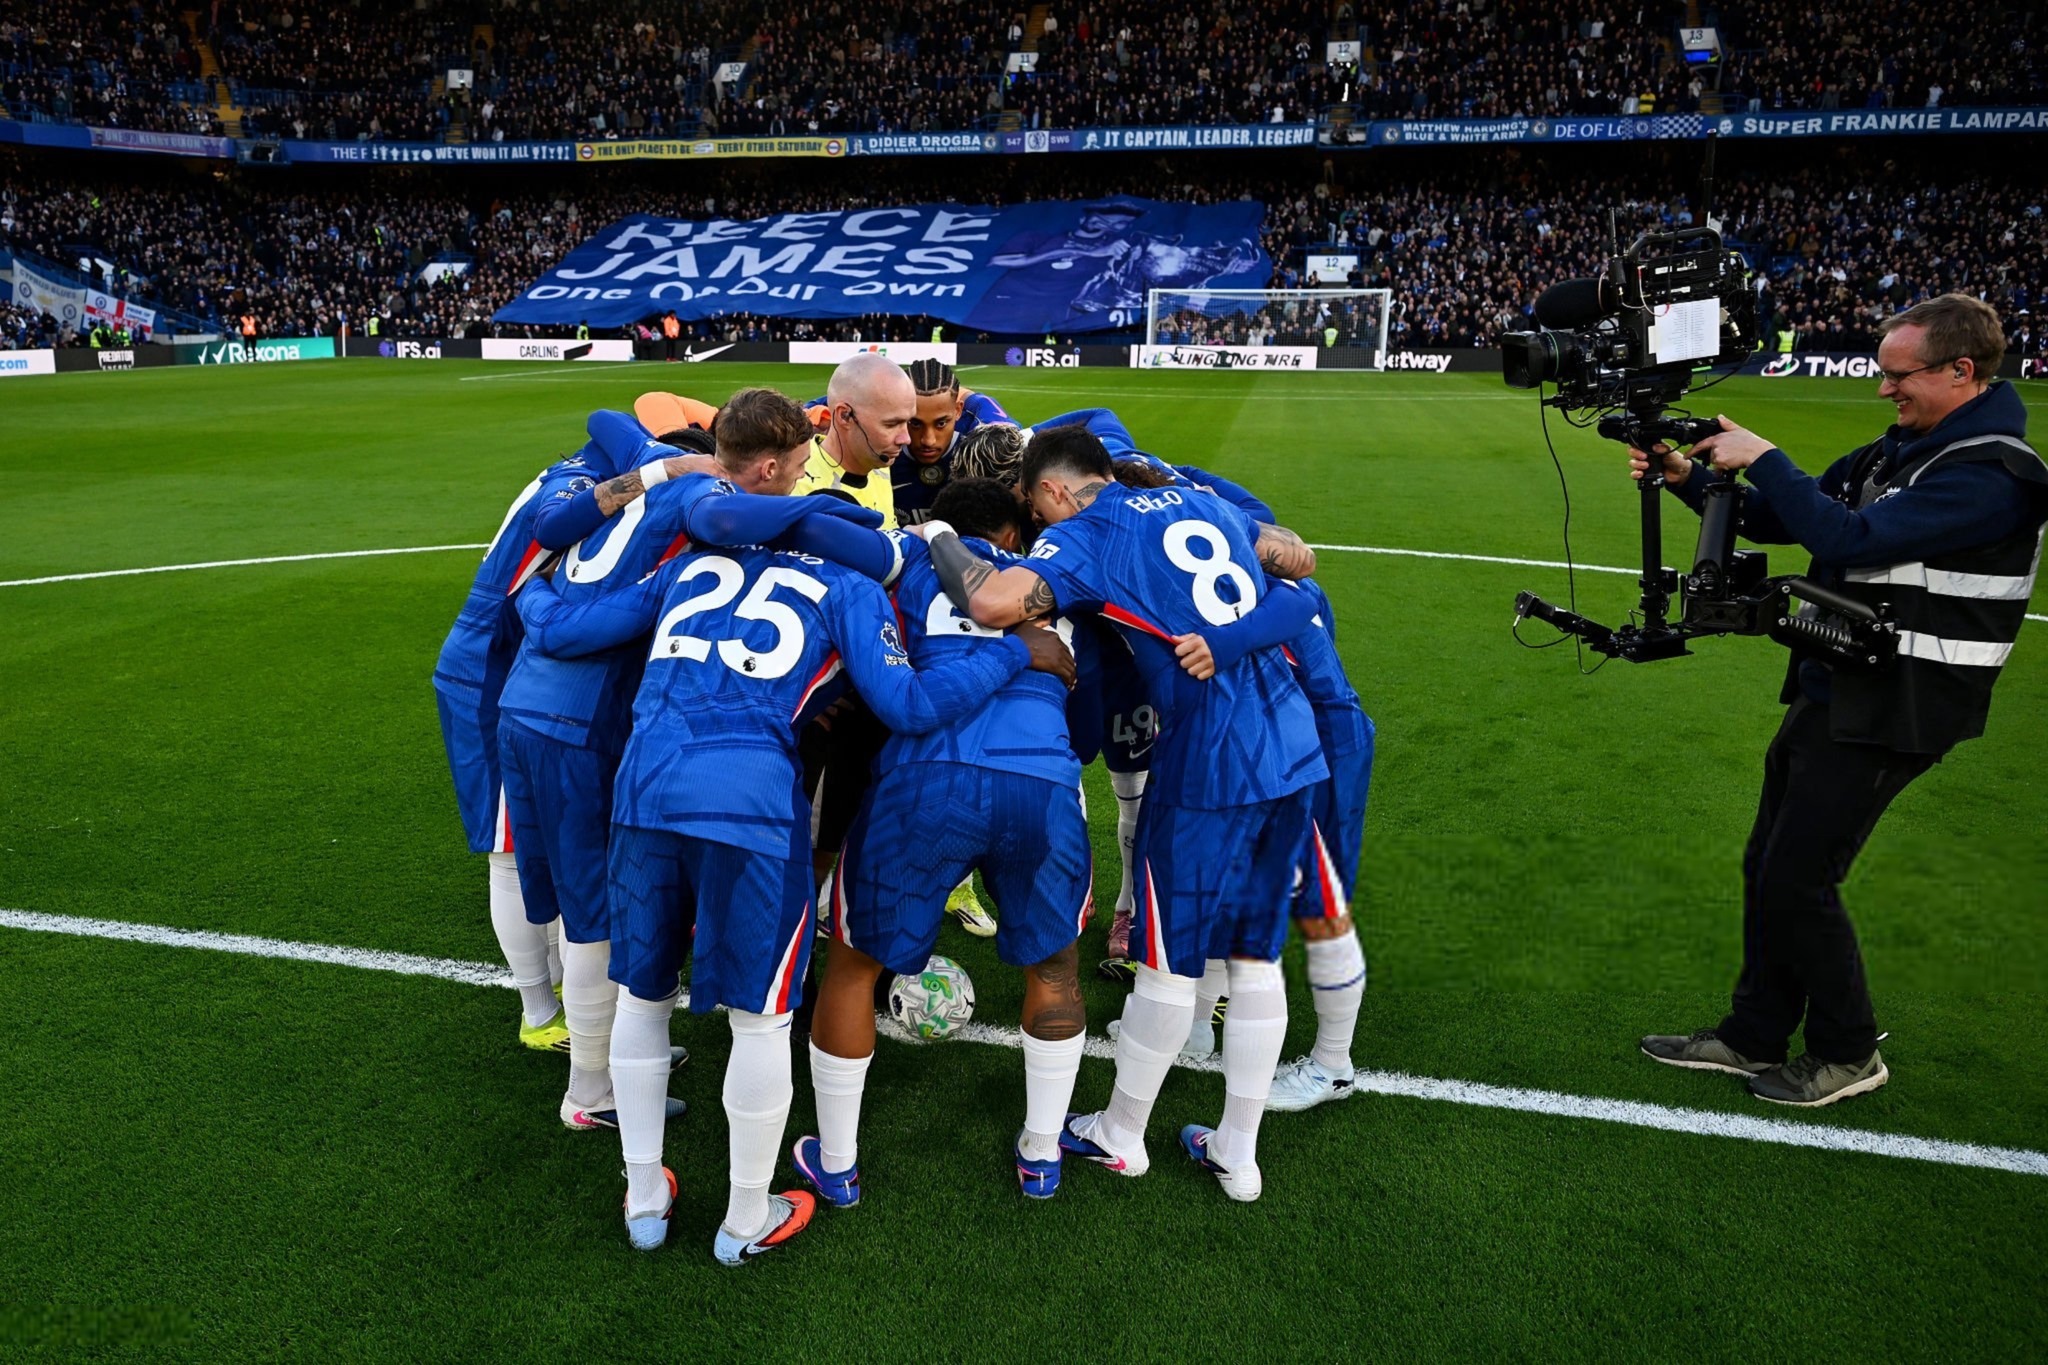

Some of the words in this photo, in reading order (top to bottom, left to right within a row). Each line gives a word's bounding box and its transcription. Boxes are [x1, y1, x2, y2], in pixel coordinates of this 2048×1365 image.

[1689, 29, 1703, 40] 13
[1338, 43, 1350, 53] 12
[1020, 54, 1030, 63] 11
[457, 71, 465, 80] 9
[729, 64, 741, 73] 10
[1403, 123, 1460, 133] MATTHEW
[1464, 120, 1529, 132] HARDING'S
[1554, 124, 1577, 138] DE
[1580, 123, 1605, 137] OF
[1743, 117, 1823, 135] SUPER
[1830, 113, 1942, 132] FRANKIE
[1950, 112, 2048, 129] LAMPAR
[869, 137, 918, 149] DIDIER
[921, 135, 982, 148] DROGBA
[1051, 136, 1070, 145] SW6
[1104, 132, 1121, 147] JT
[1124, 130, 1192, 148] CAPTAIN,
[1195, 129, 1254, 147] LEADER,
[1257, 127, 1314, 146] LEGEND
[1404, 132, 1434, 141] BLUE
[1438, 133, 1447, 141] &
[1455, 132, 1489, 142] WHITE
[1491, 131, 1526, 141] ARMY
[331, 146, 358, 160] THE
[435, 146, 469, 160] WE'VE
[471, 146, 496, 160] WON
[498, 145, 509, 159] IT
[511, 145, 529, 159] ALL
[598, 146, 613, 156] THE
[615, 145, 635, 156] ONLY
[638, 143, 664, 155] PLACE
[666, 144, 677, 154] TO
[679, 144, 690, 154] BE
[718, 142, 744, 153] EVERY
[747, 141, 775, 152] OTHER
[777, 141, 822, 152] SATURDAY
[556, 242, 974, 281] JAMES
[1325, 256, 1339, 268] 12
[527, 284, 632, 301] One
[842, 281, 966, 298] Own
[397, 341, 442, 359] IFS.ai
[519, 345, 559, 358] CARLING
[1026, 347, 1081, 368] IFS.ai
[1125, 490, 1183, 514] ENZO
[1162, 519, 1257, 627] 8
[649, 555, 829, 680] 25
[1112, 704, 1154, 746] 49
